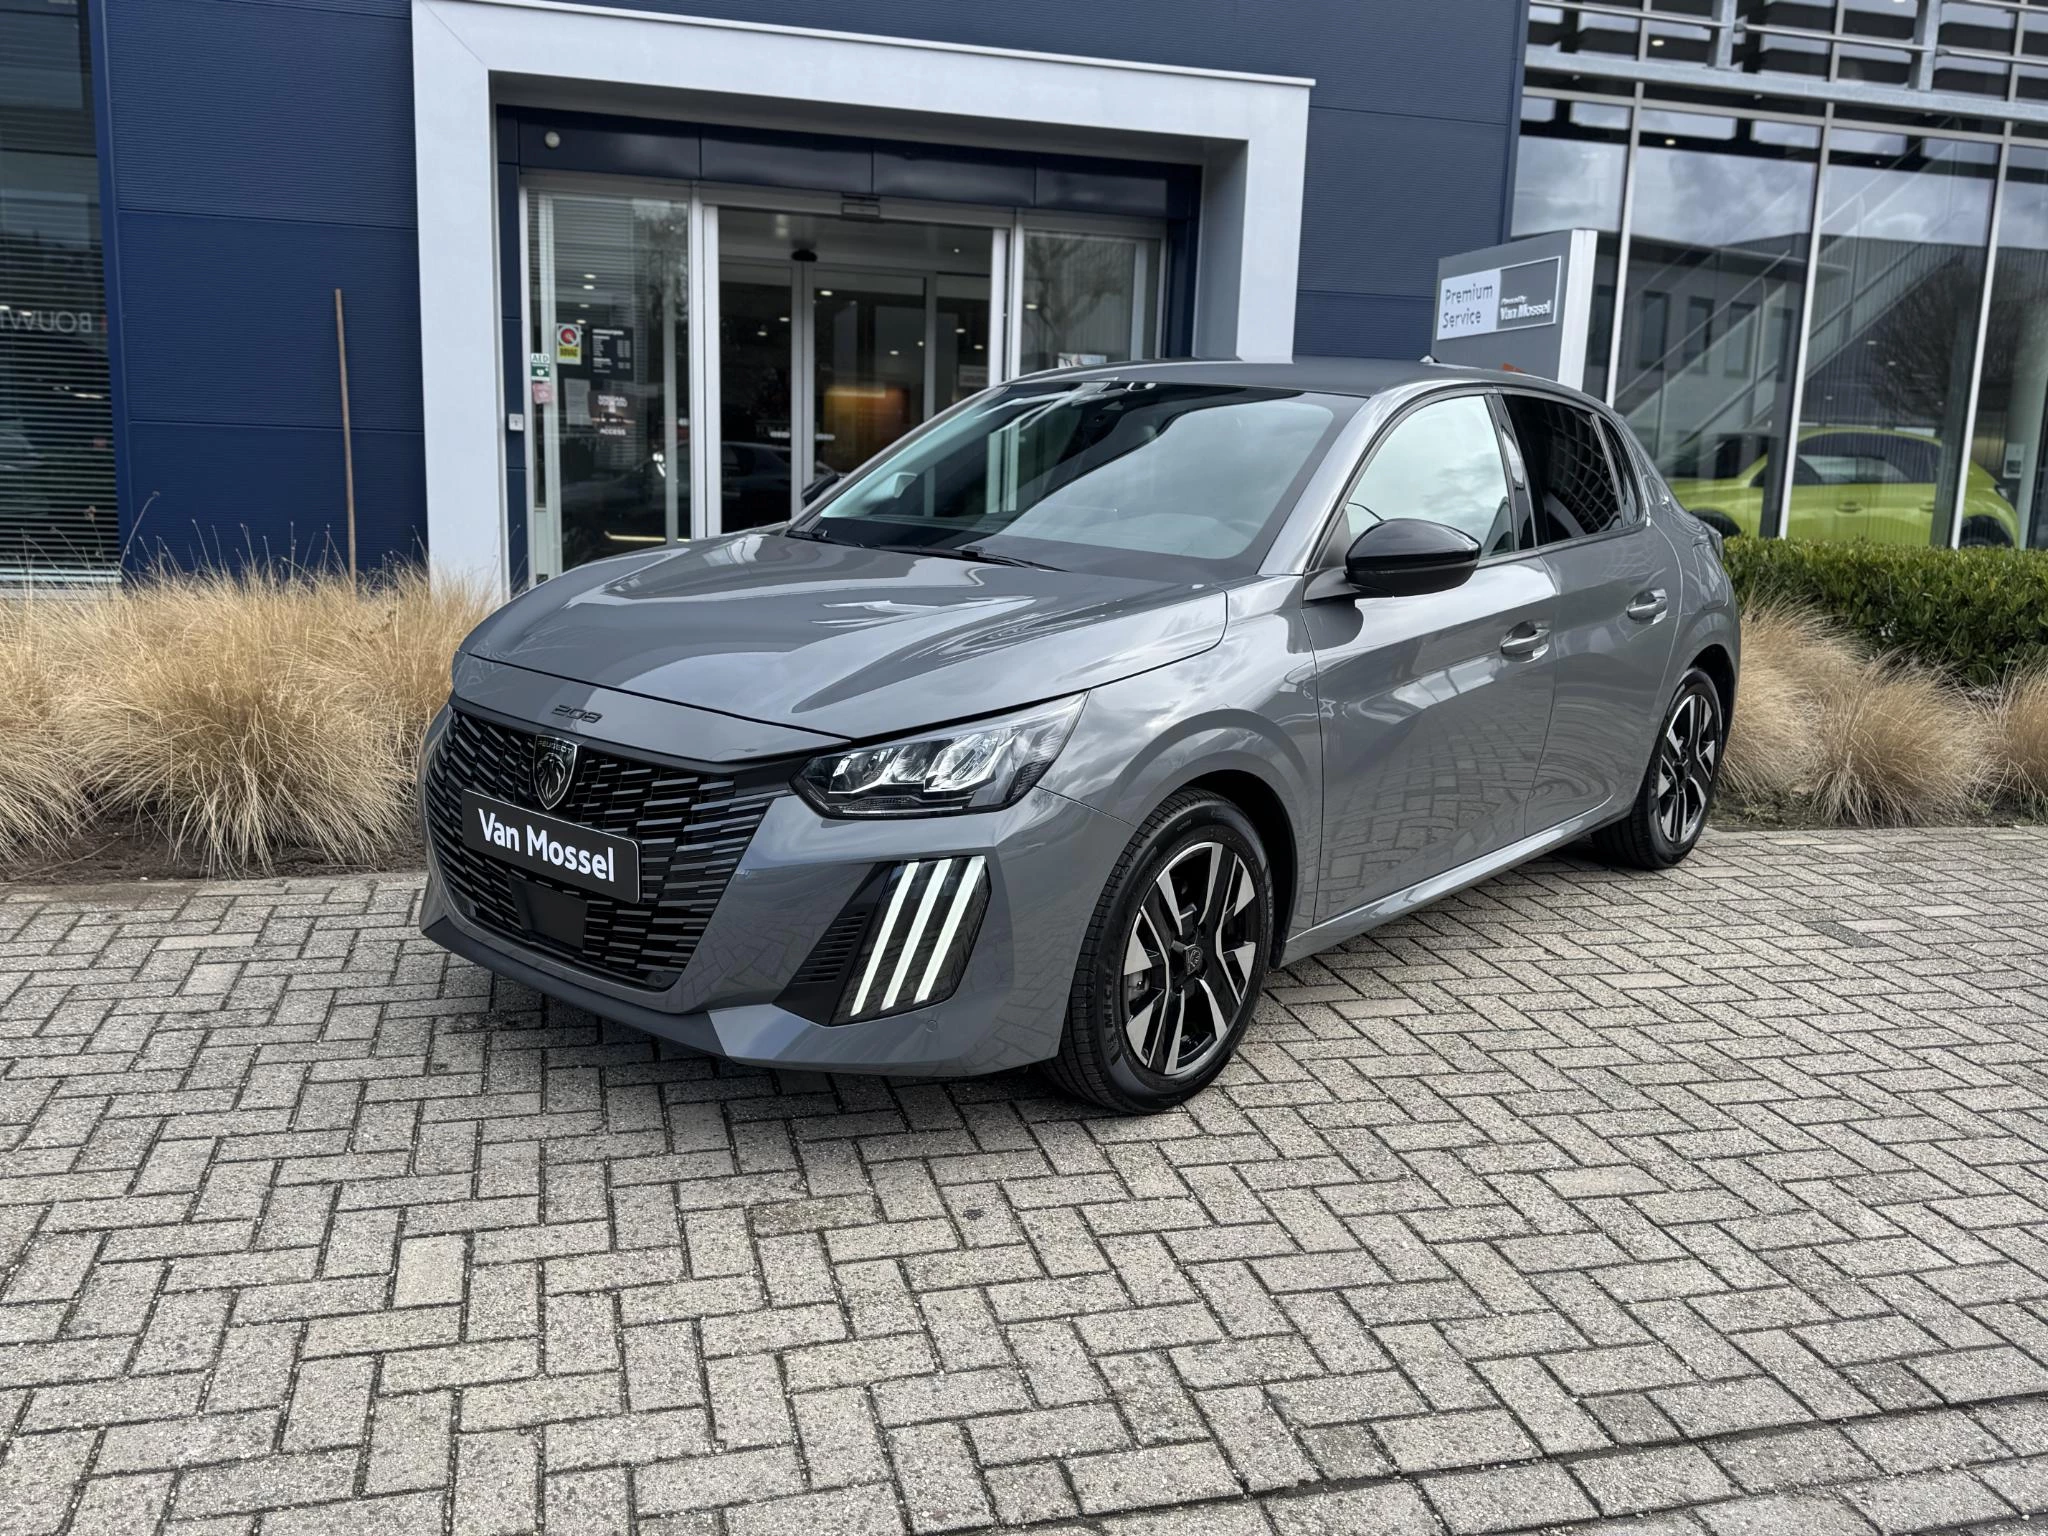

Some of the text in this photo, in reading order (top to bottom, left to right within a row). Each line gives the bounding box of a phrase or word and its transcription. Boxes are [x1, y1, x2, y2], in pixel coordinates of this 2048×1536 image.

[1445, 283, 1493, 305] Premium
[1442, 308, 1481, 329] Service
[1500, 300, 1551, 320] Van Mossel
[532, 354, 549, 362] AED
[551, 704, 603, 724] 208
[537, 740, 573, 754] PEUGEOT
[478, 808, 615, 882] Van Mossel
